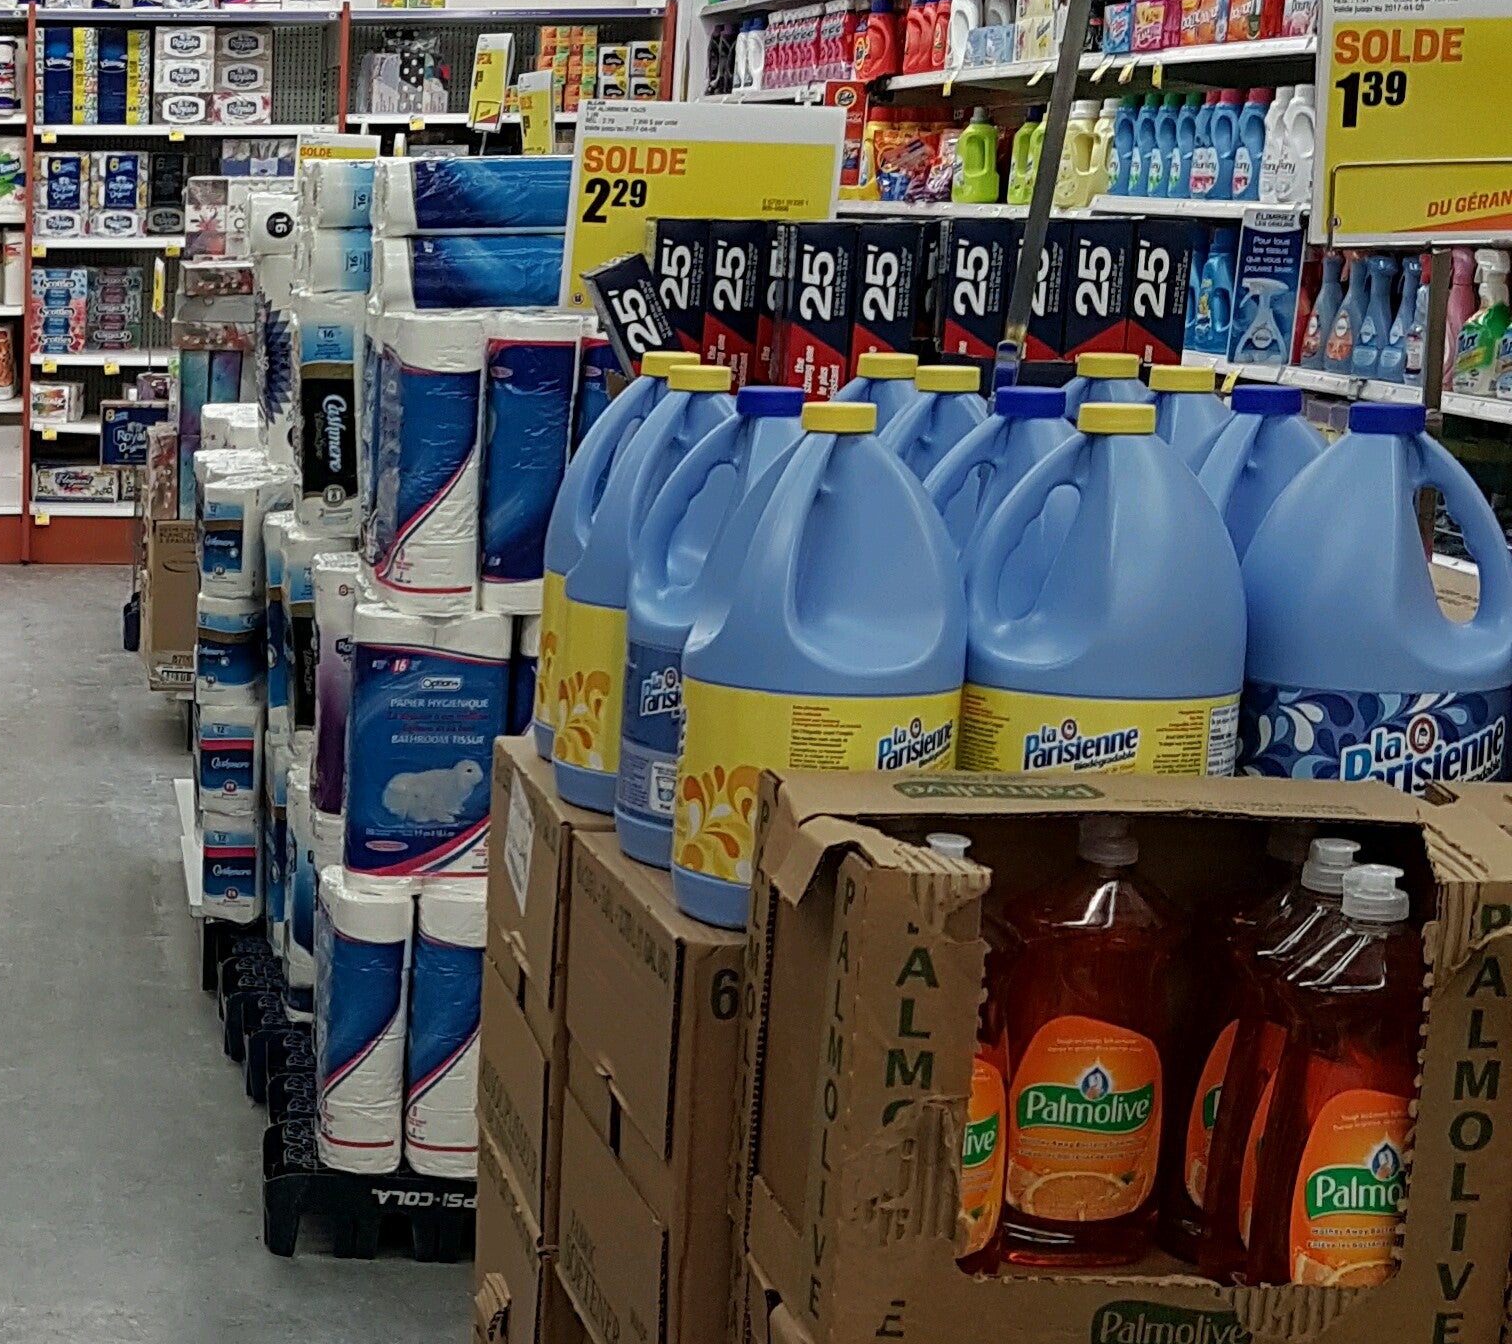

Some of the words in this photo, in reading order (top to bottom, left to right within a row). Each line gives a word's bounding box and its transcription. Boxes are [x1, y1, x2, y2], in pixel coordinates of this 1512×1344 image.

[170, 36, 200, 50] Royale
[1334, 27, 1465, 65] SOLDE
[169, 69, 200, 83] Royale
[299, 146, 332, 158] SOLDE
[584, 145, 688, 175] SOLDE
[1426, 199, 1453, 218] DU
[1455, 188, 1512, 213] GÉRAN
[1253, 237, 1271, 246] Pour
[1273, 237, 1291, 246] tous
[1262, 256, 1281, 264] vous
[322, 394, 348, 473] Cashmere
[390, 698, 425, 708] PAPIER
[391, 734, 448, 745] BATHROOM
[877, 719, 955, 770] Parisienne
[892, 726, 908, 746] la
[1040, 723, 1057, 744] la
[1374, 730, 1403, 763] la
[1023, 728, 1139, 771] Parisienne
[1343, 719, 1505, 794] Parisienne
[710, 967, 739, 1021] 6
[808, 880, 856, 1318] PALMOLIVE
[1024, 1086, 1150, 1124] Palmolive
[1315, 1172, 1404, 1210] Palmo
